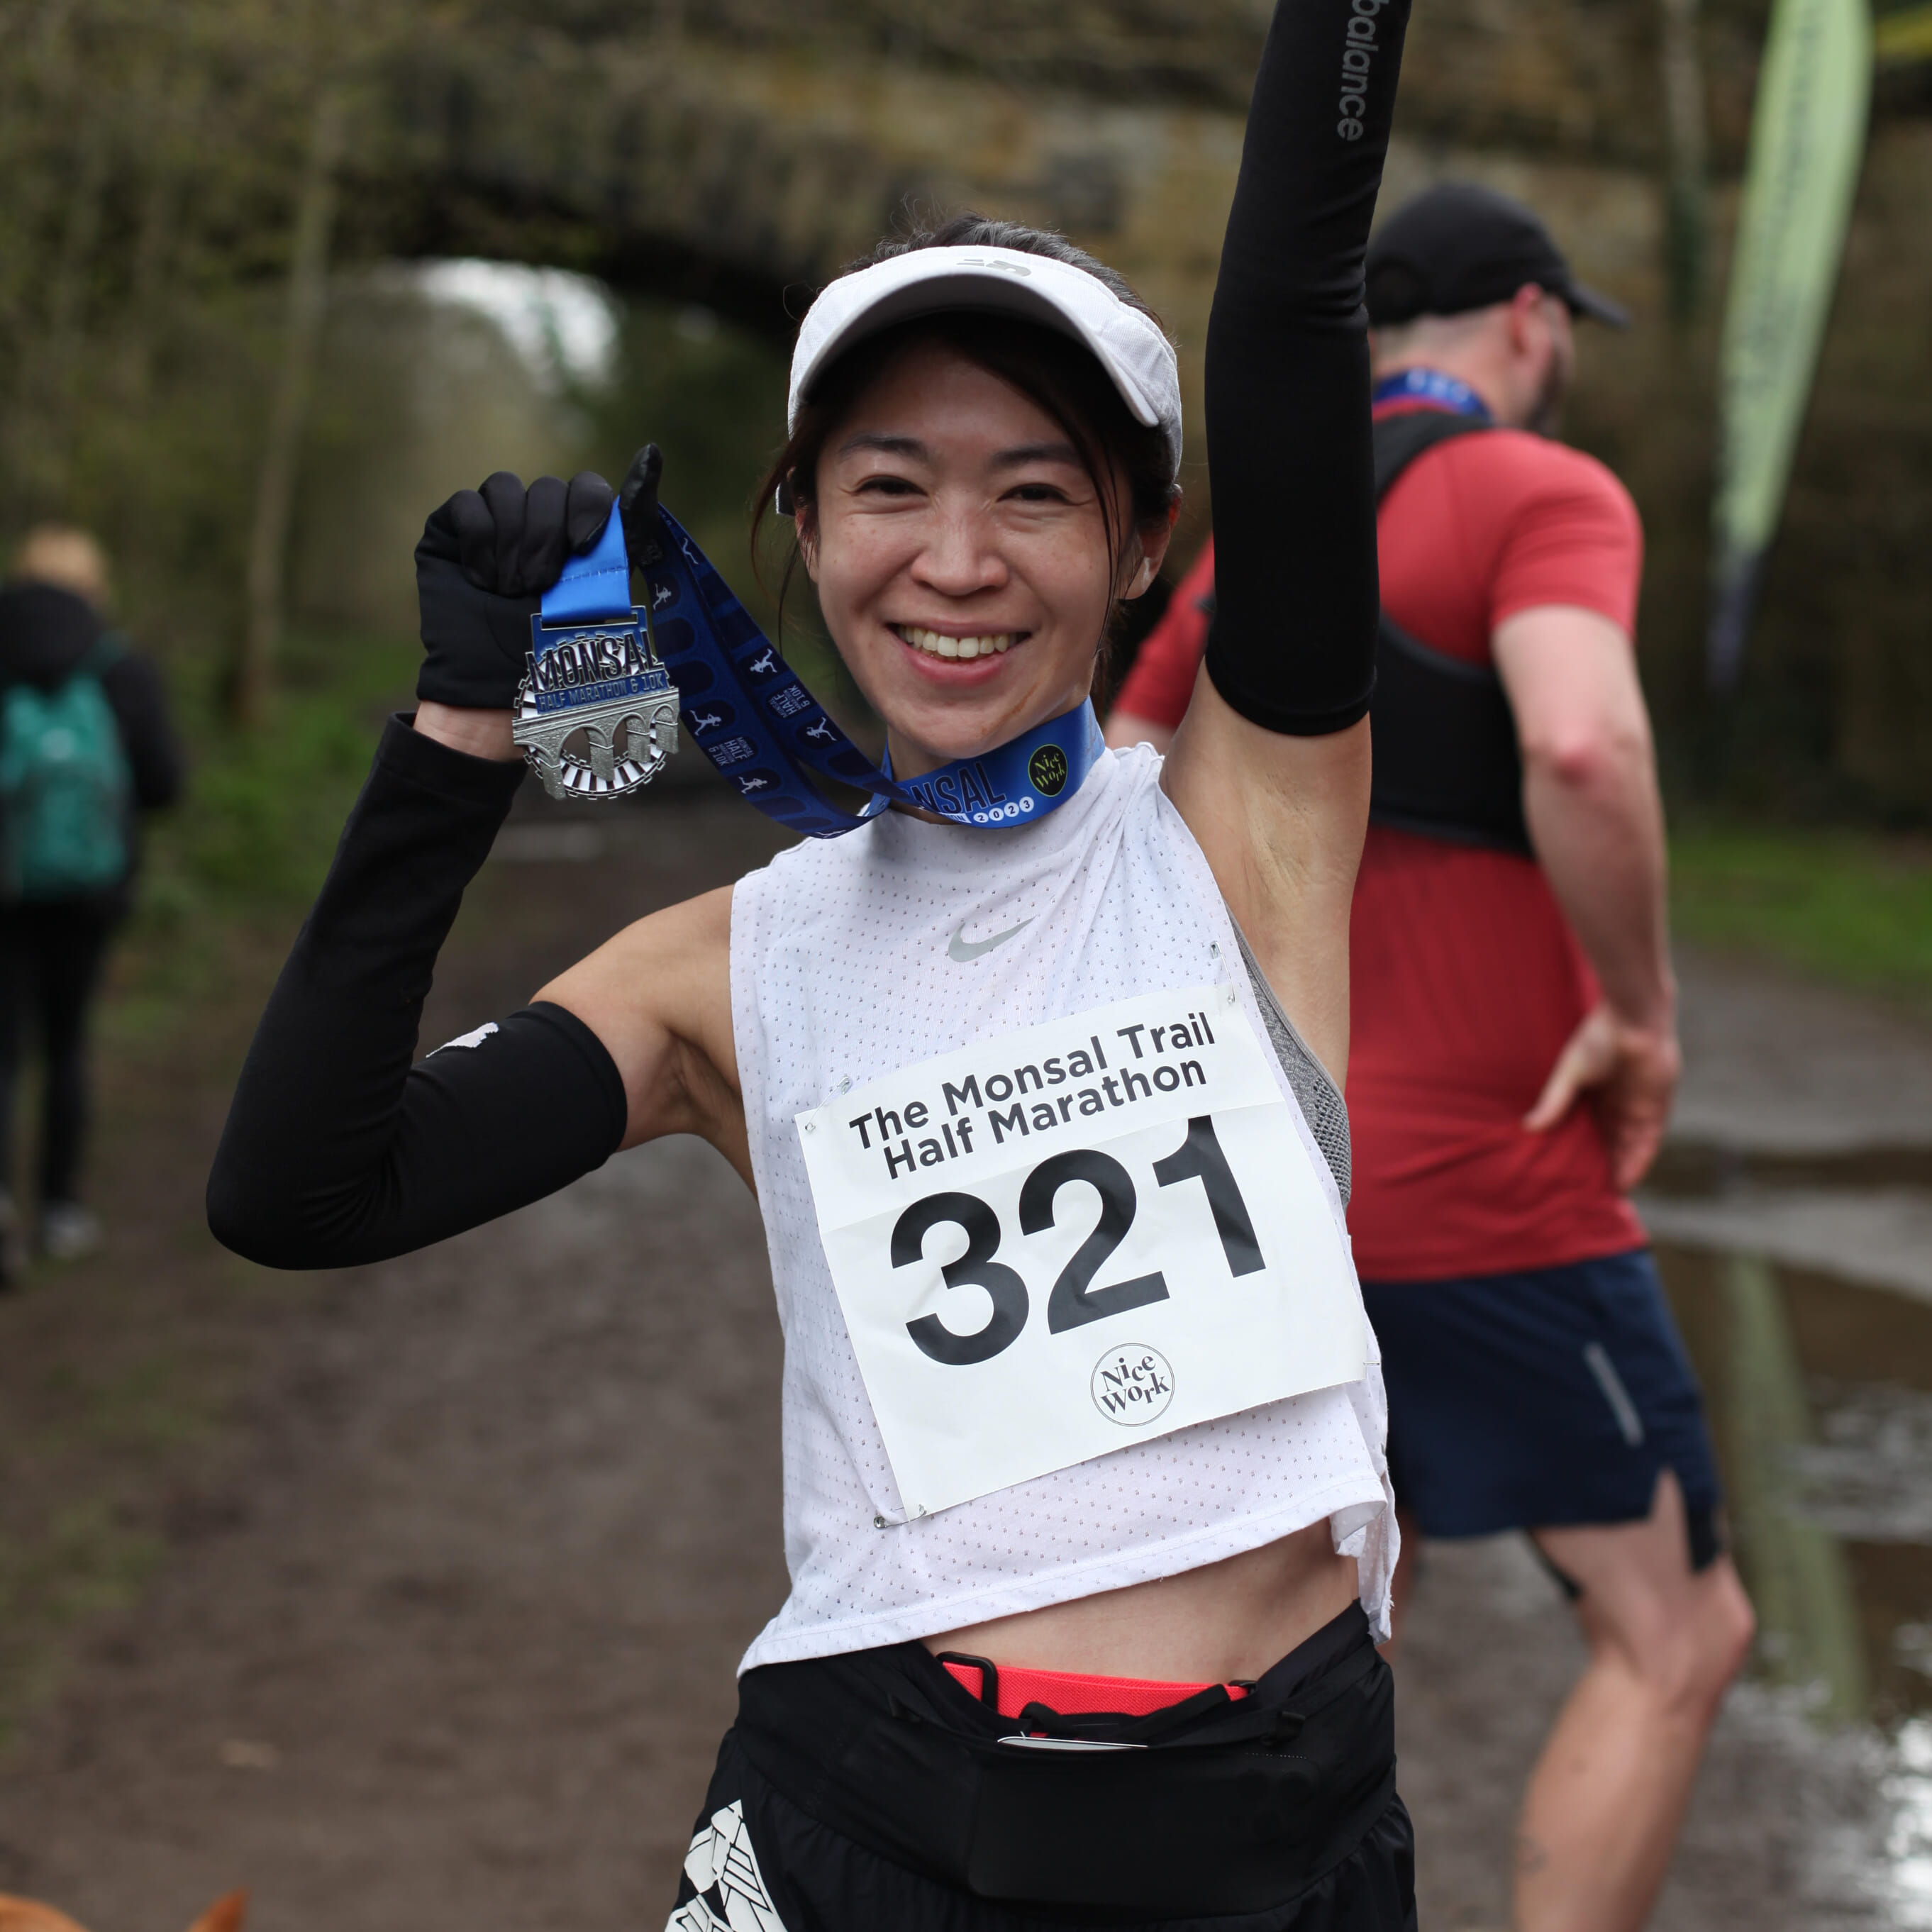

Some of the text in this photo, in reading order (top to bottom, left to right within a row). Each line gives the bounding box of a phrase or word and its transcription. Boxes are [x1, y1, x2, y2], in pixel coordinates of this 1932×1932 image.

[1337, 0, 1389, 141] balance
[525, 628, 665, 693] MONSAL
[538, 692, 566, 711] HALF
[568, 679, 627, 706] MARATHON
[641, 673, 665, 691] 10K
[773, 694, 797, 715] HALF
[788, 684, 806, 701] 10K
[713, 752, 730, 767] 10K
[724, 740, 748, 759] HALF
[1035, 753, 1059, 775] Nice
[1036, 762, 1065, 788] Work
[976, 798, 1032, 822] 2023
[849, 1012, 1215, 1150] The Monsal Trail
[884, 1057, 1206, 1180] Half Marathon
[891, 1115, 1266, 1366] 321
[1100, 1355, 1156, 1392] Nice
[1100, 1372, 1171, 1414] Work
